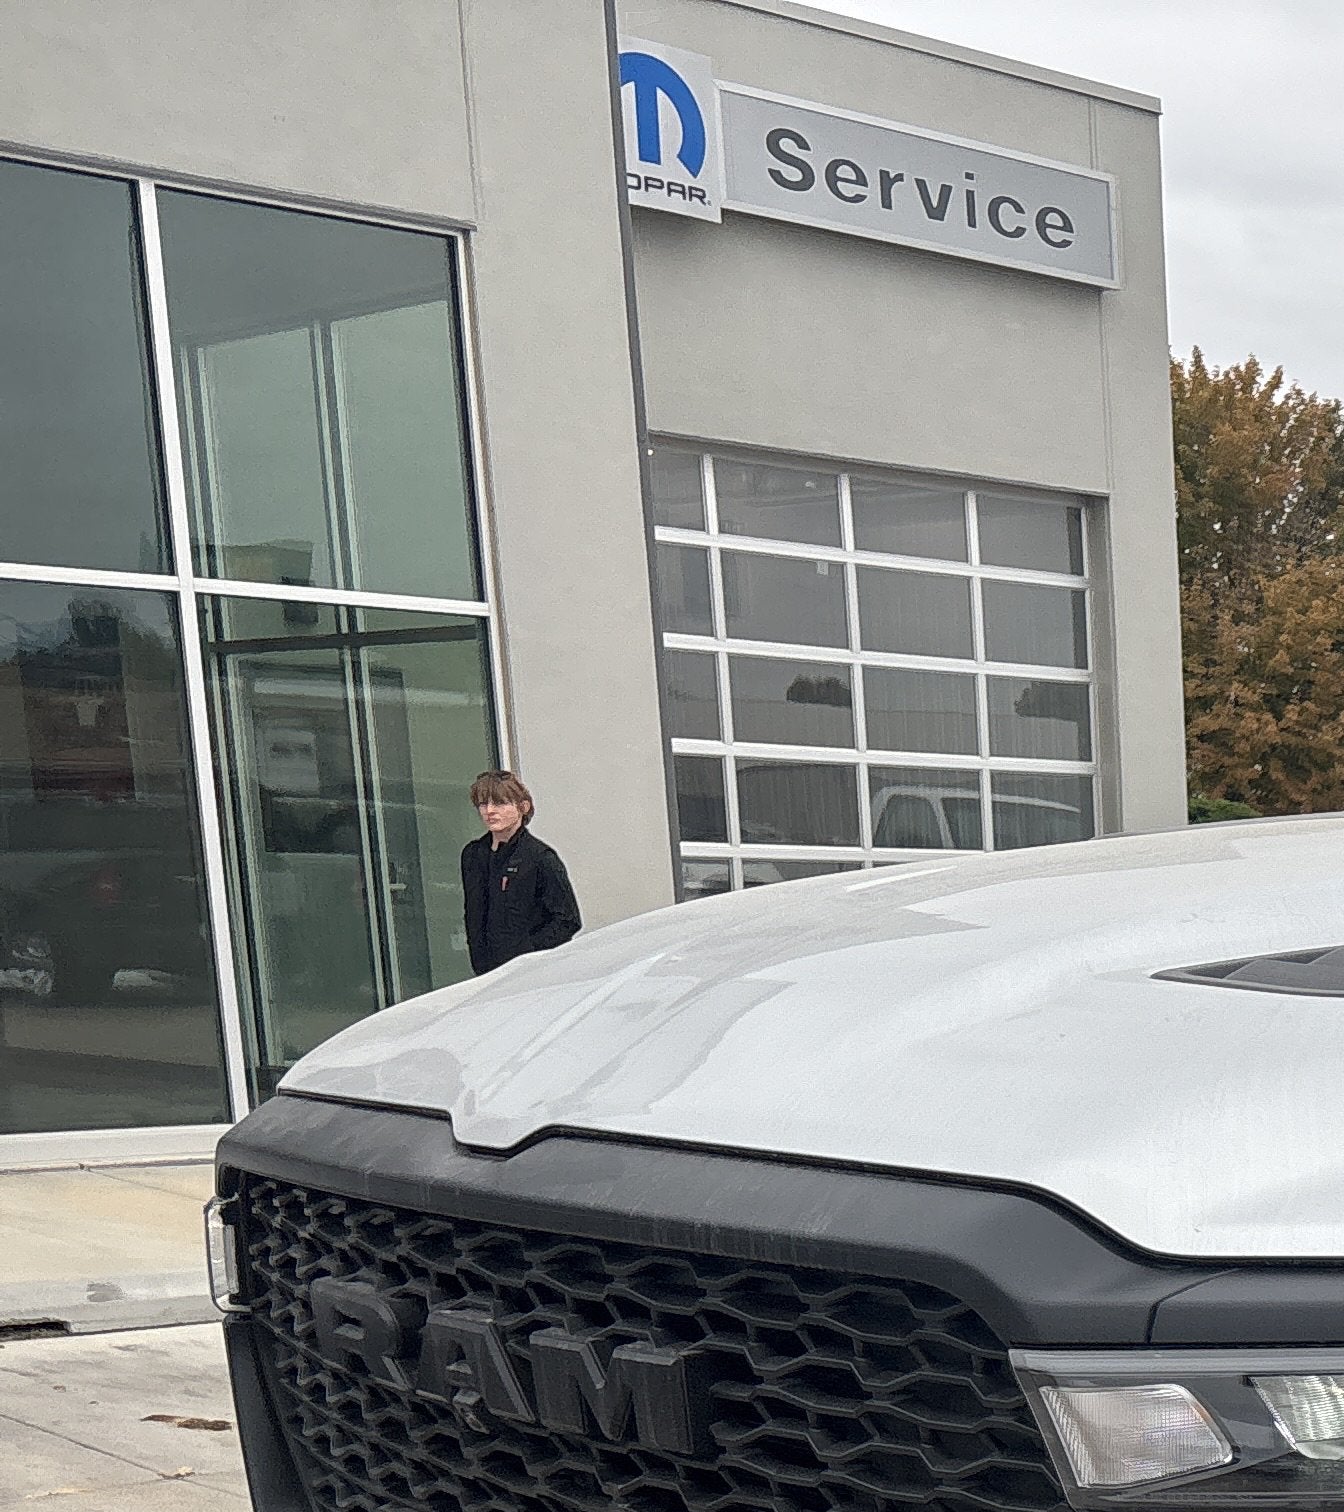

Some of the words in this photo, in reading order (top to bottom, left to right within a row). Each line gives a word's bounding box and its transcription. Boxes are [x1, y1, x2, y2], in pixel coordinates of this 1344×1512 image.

[627, 172, 706, 206] OPAR
[765, 127, 1076, 249] Service
[310, 1274, 696, 1455] RAM
